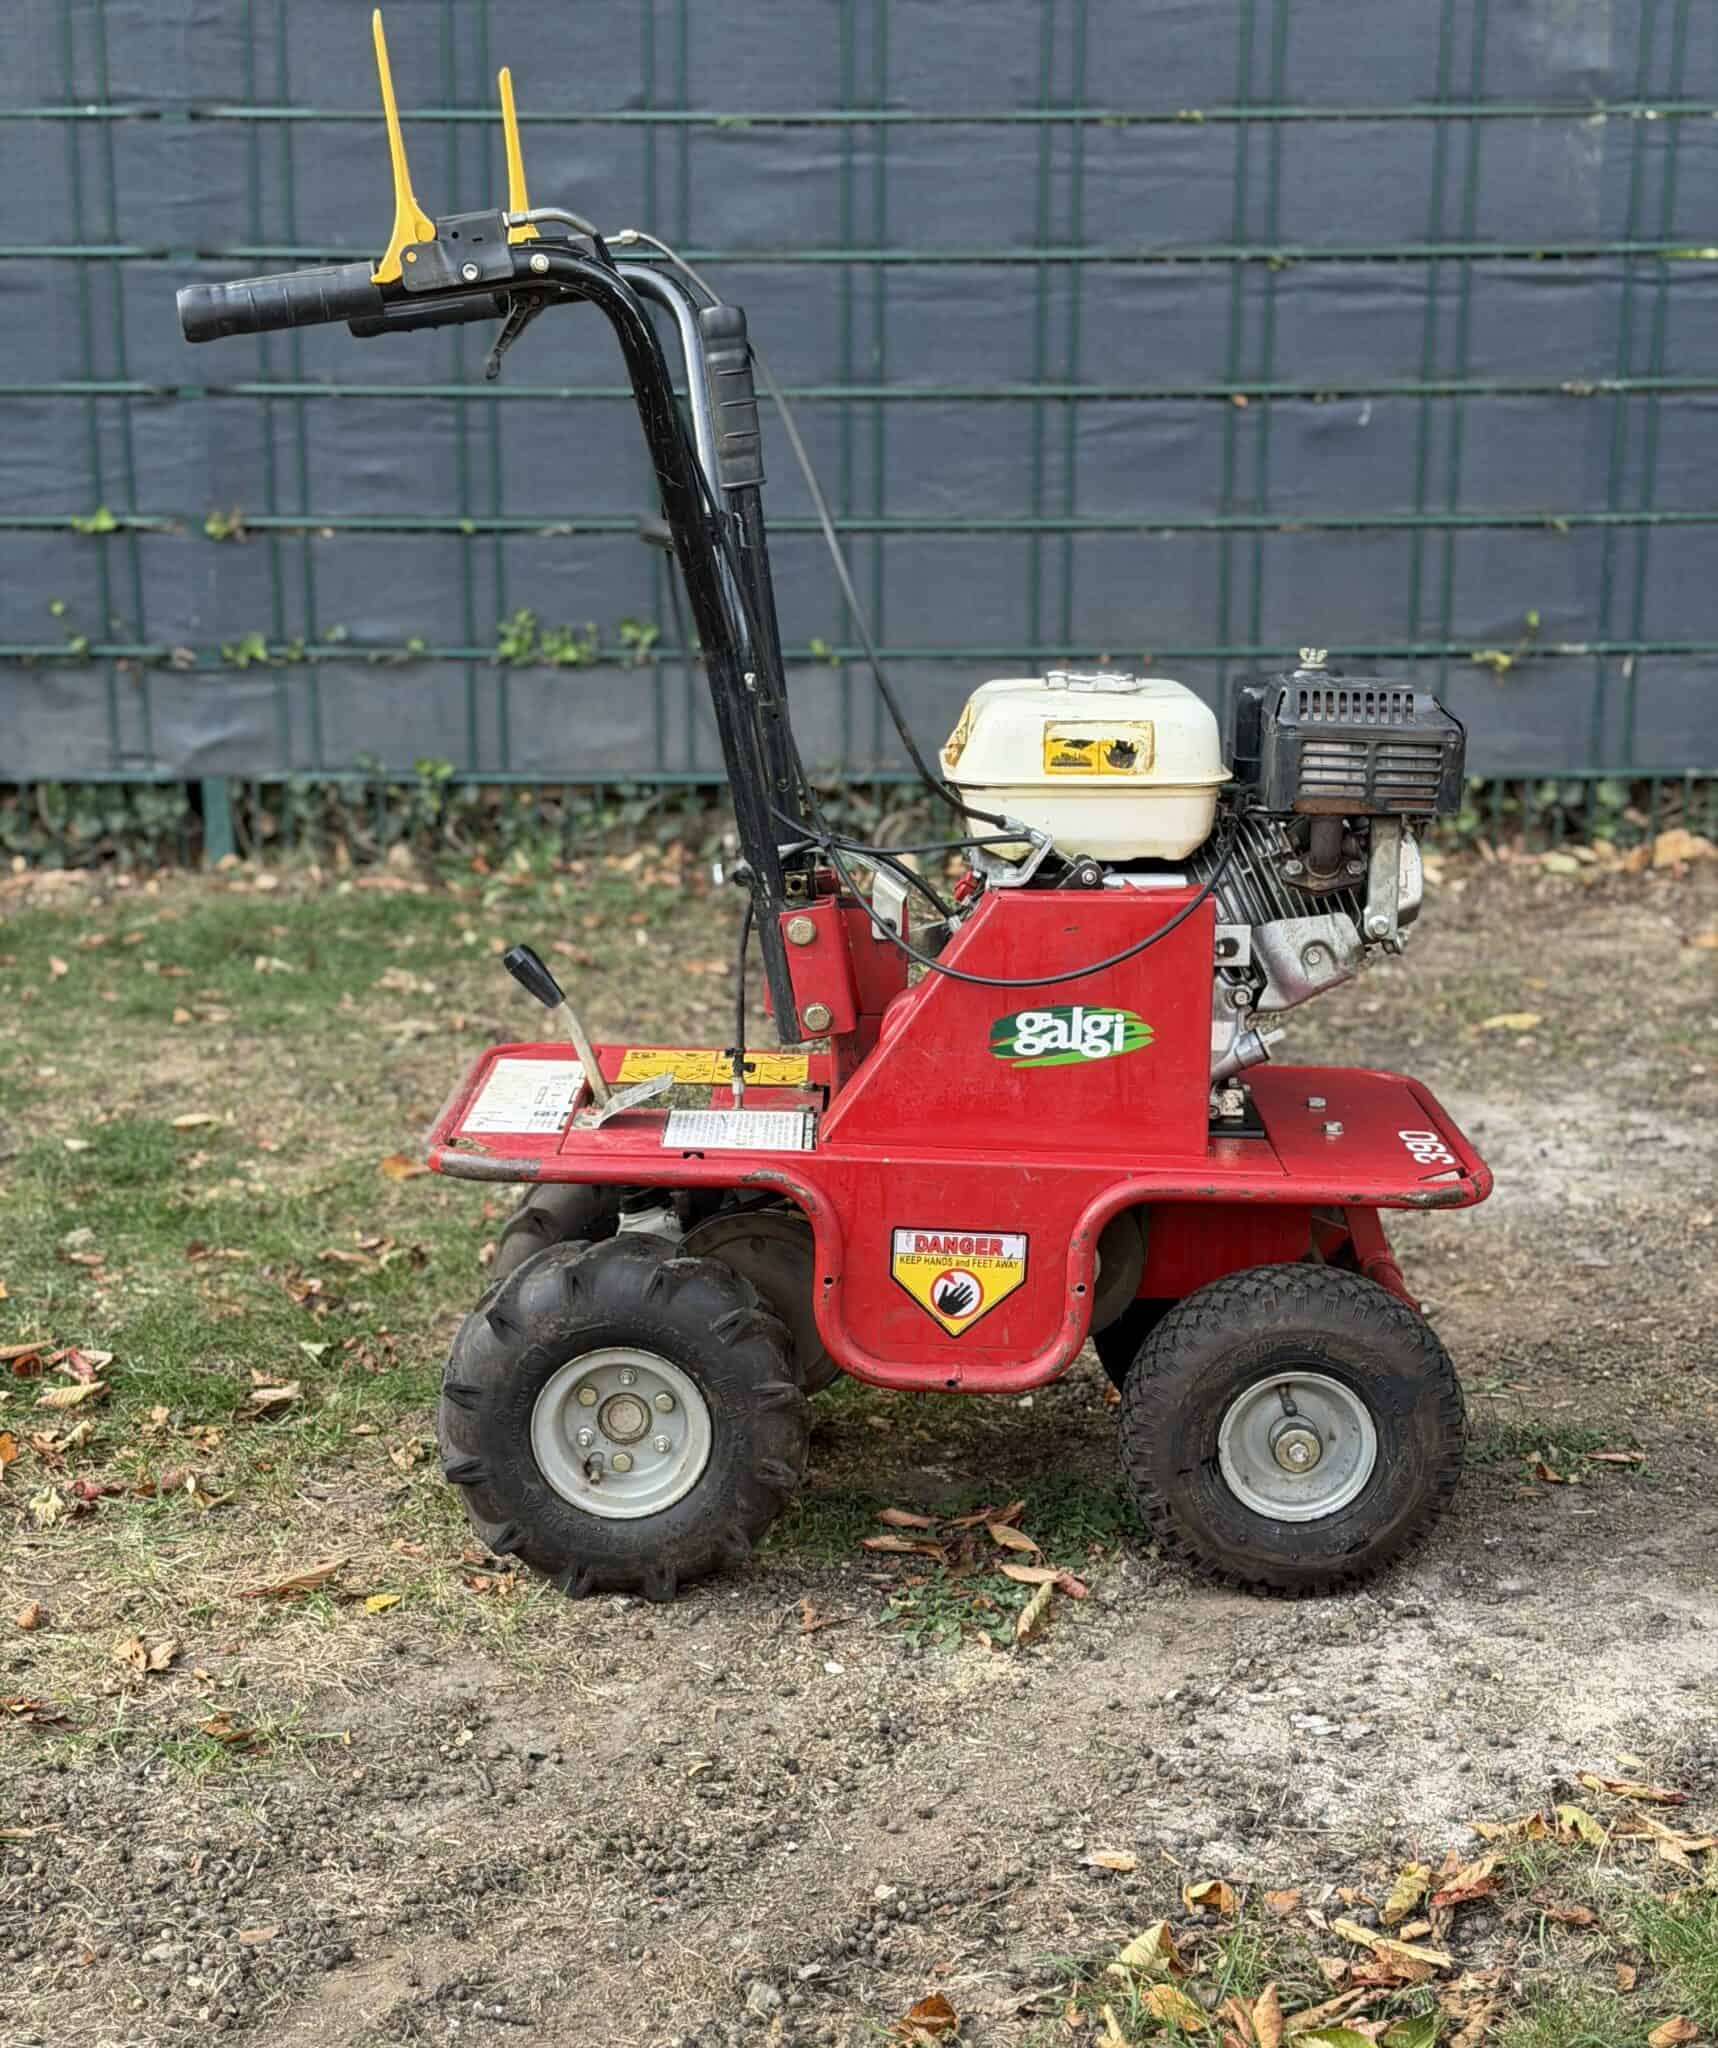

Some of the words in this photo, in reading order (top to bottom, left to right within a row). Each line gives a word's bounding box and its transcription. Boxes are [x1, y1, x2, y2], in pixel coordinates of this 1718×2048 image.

[1013, 1006, 1126, 1058] galgi
[1398, 1130, 1456, 1165] 390
[913, 1234, 1005, 1257] DANGER
[899, 1255, 922, 1265] KEEP
[924, 1256, 953, 1267] HANDS
[955, 1257, 970, 1267] and
[972, 1258, 993, 1269] FEET
[995, 1260, 1019, 1270] AWAY
